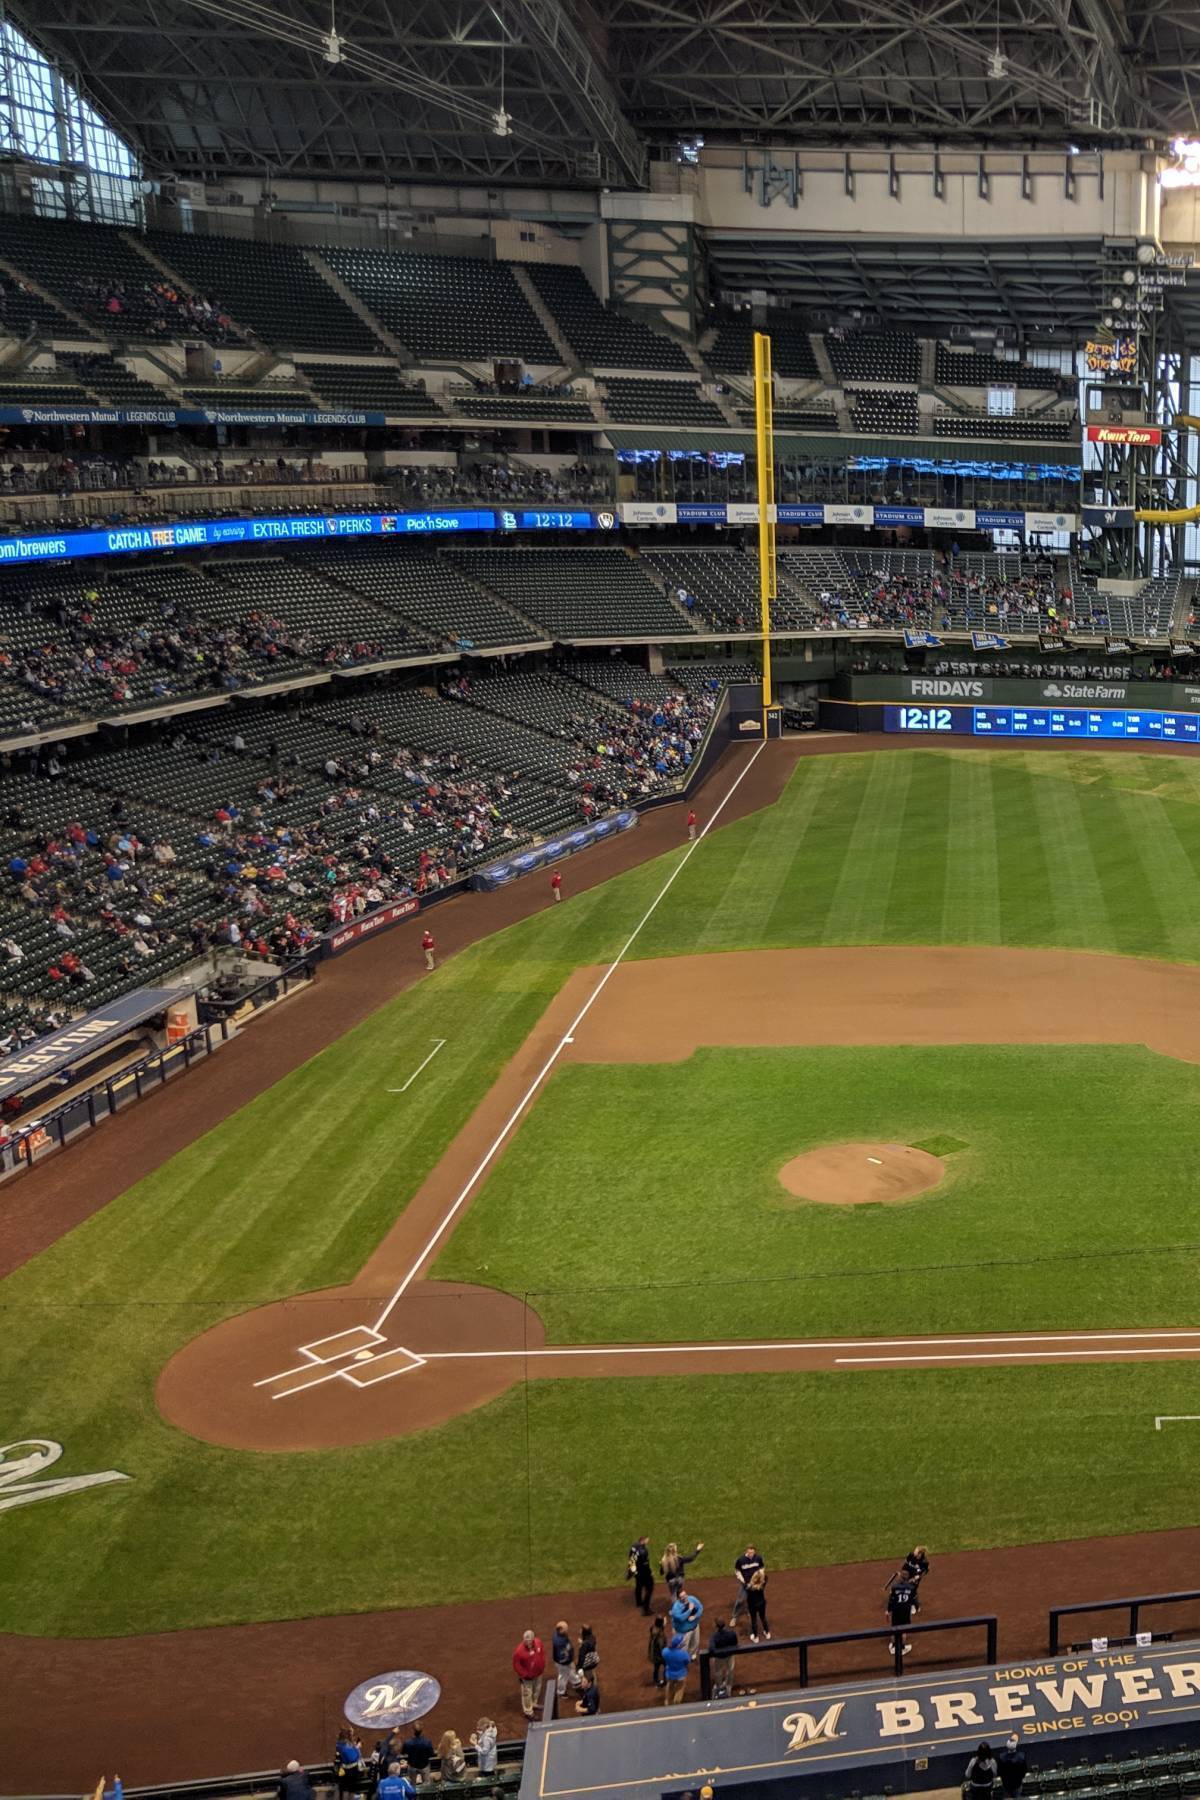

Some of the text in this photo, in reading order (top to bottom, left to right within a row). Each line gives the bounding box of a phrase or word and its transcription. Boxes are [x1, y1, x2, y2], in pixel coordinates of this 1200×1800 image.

[1085, 338, 1137, 356] BERNIE'S
[1087, 356, 1137, 373] DUGOUT
[35, 411, 176, 422] Northwestern Mutual LEGENDS CLUB
[217, 413, 366, 424] Northwestern Mutual LEGENDS CLUB
[435, 518, 459, 529] Save
[535, 514, 573, 528] 12:12
[875, 512, 905, 520] STADIUM
[977, 516, 1007, 524] STADIUM
[108, 519, 372, 550] CATCH A FREE GAME! by earning EXTRA FRESH PERKS
[911, 680, 984, 697] FRIDAYS
[899, 708, 952, 730] 12:12
[897, 1593, 909, 1603] 19
[994, 1654, 1137, 1682] HOME OF THE
[1022, 1709, 1140, 1735] SINCE 2001
